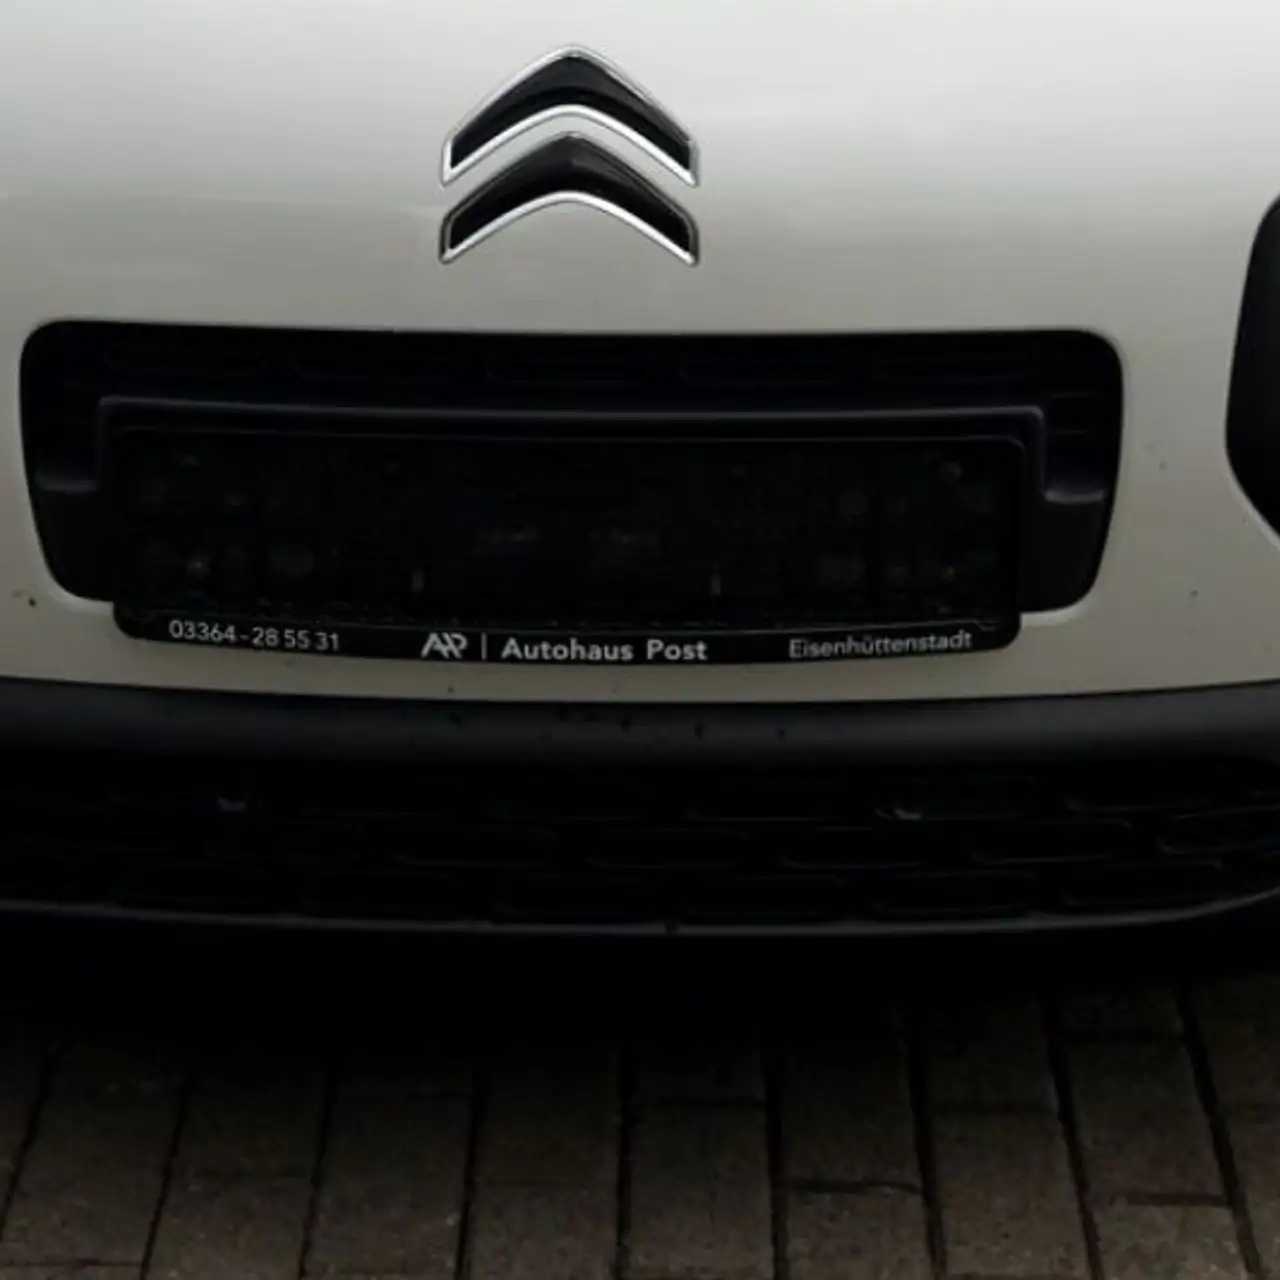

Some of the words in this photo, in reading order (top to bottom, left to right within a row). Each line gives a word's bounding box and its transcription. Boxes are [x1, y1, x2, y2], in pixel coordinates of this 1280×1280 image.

[500, 636, 635, 662] Autohaus
[646, 637, 709, 661] Post
[788, 628, 974, 659] Eisenhüttenstadt
